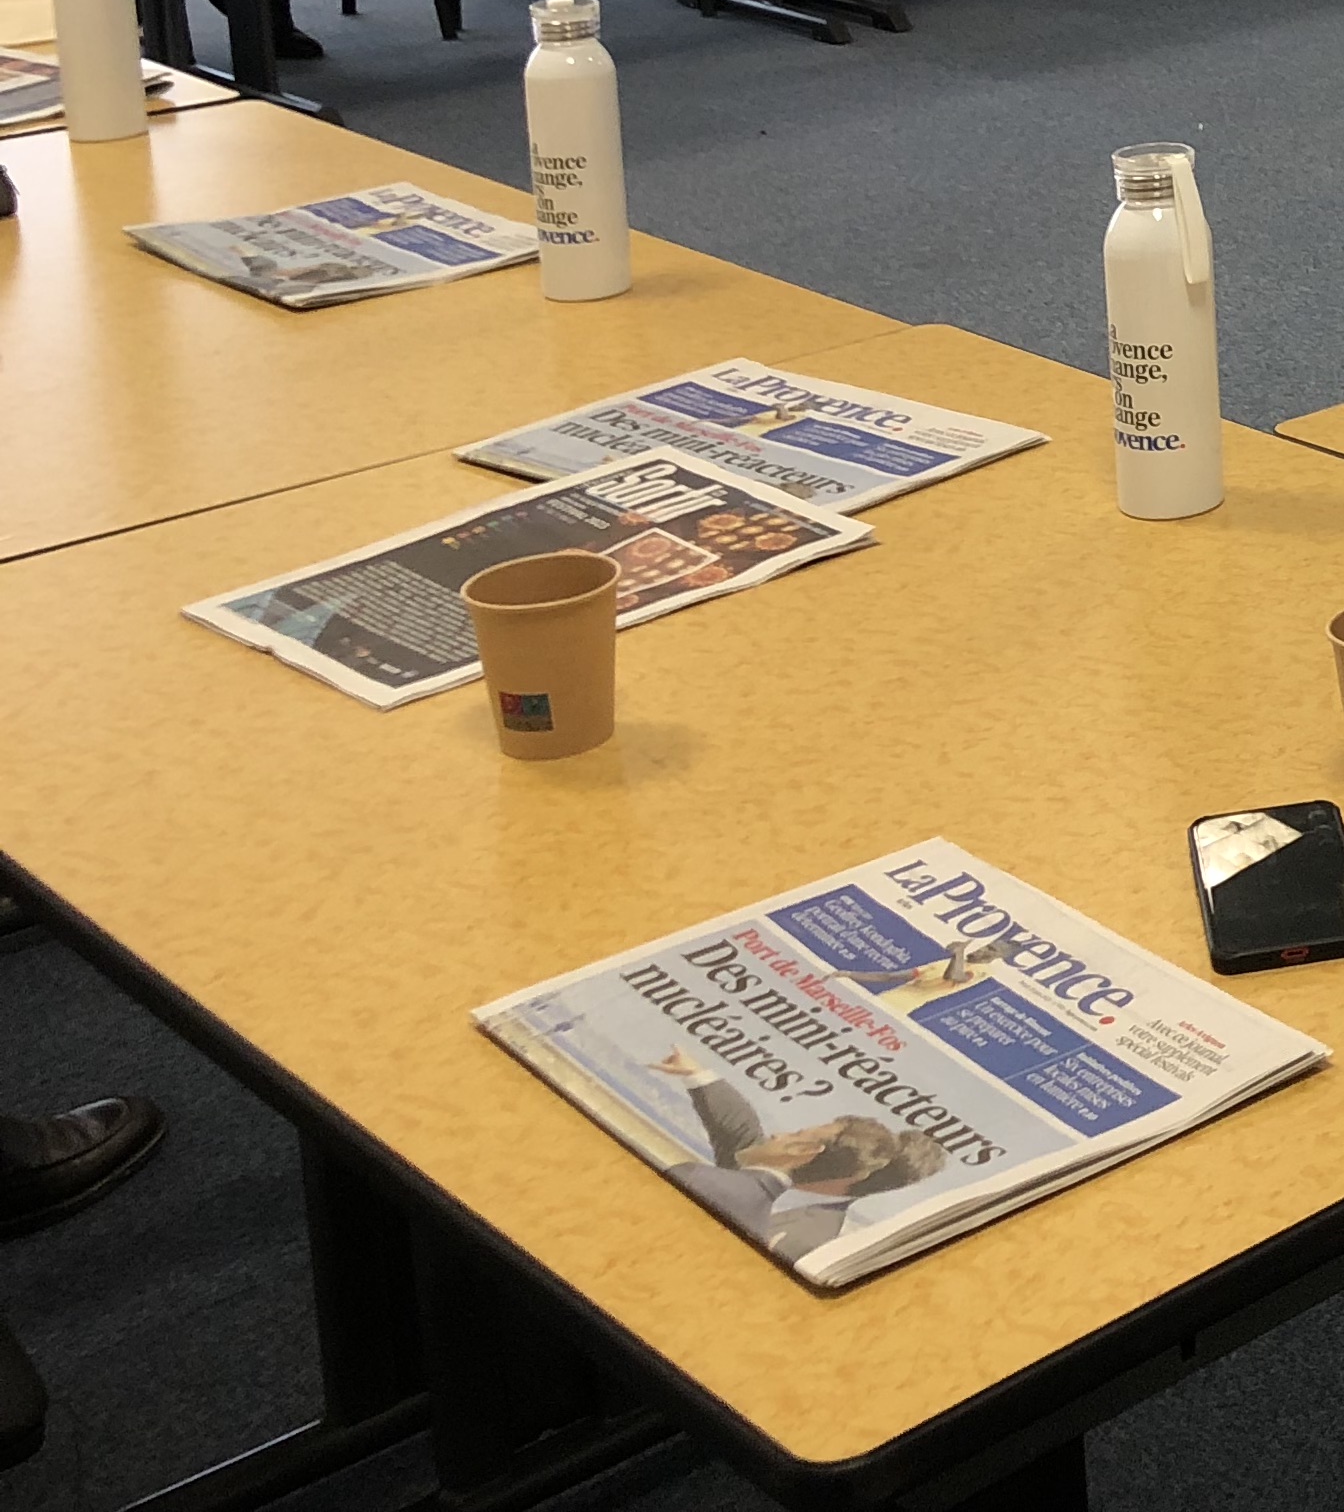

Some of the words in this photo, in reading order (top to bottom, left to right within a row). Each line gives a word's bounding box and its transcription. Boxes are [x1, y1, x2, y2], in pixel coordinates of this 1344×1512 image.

[534, 171, 582, 190] ange,
[536, 209, 578, 228] ange
[1111, 360, 1167, 384] ange,
[1115, 391, 1133, 409] on
[585, 409, 654, 431] Des
[1115, 407, 1161, 431] ange
[547, 423, 660, 454] nucléa
[586, 463, 729, 523] Sortir
[730, 929, 783, 961] Port
[767, 957, 805, 978] de
[791, 975, 912, 1050] Marseille-Fos
[1145, 1019, 1178, 1036] Avec
[680, 940, 771, 994] Des
[741, 993, 1008, 1163] mini-réacteurs
